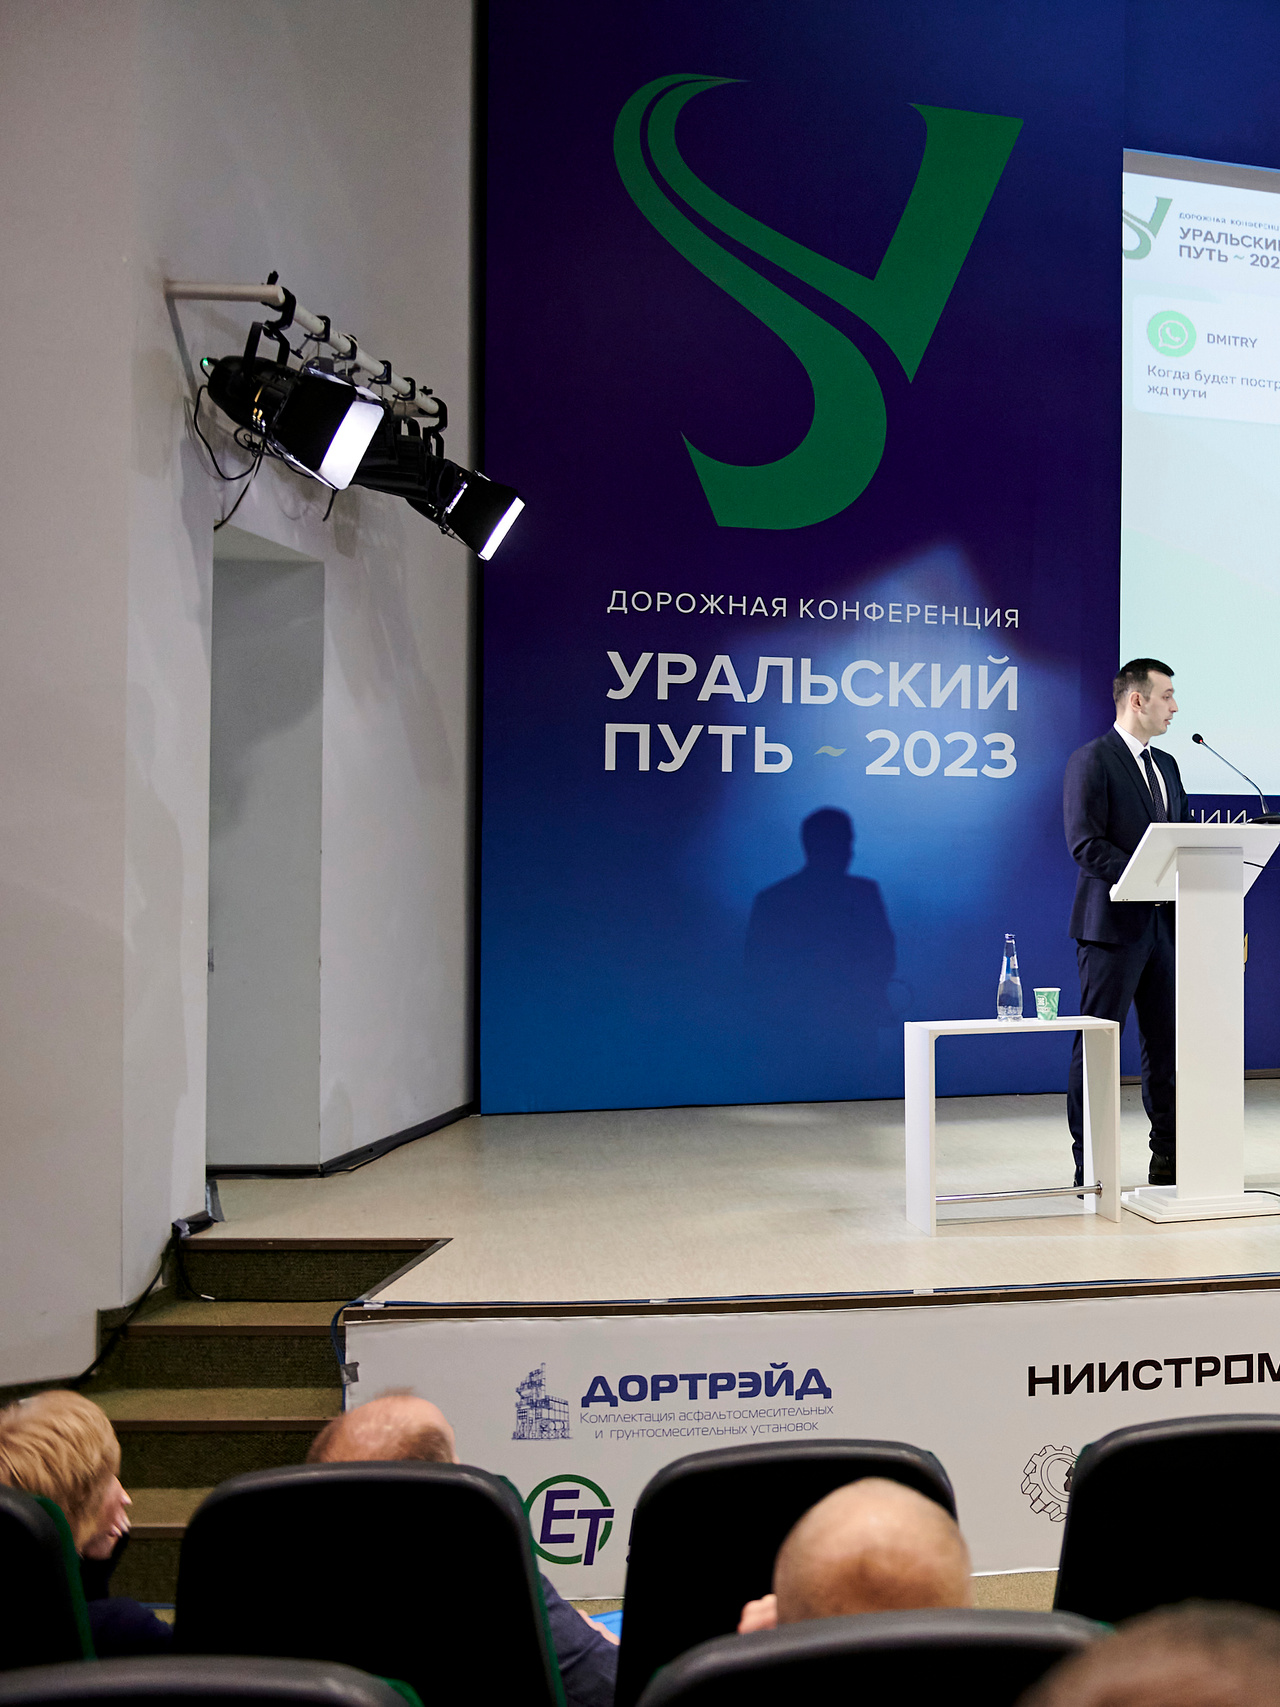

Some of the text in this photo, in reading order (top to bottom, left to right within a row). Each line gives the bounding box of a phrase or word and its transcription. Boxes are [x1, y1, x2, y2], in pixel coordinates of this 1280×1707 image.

[1179, 244, 1228, 263] ПУТЬ
[1206, 333, 1258, 348] DMITRY
[1147, 364, 1190, 381] Когда
[1194, 369, 1237, 385] будет
[1147, 384, 1207, 399] жд пути
[606, 589, 1020, 630] ДОРОЖНАЯ КОНФЕРЕНЦИЯ
[605, 650, 1019, 711] УРАЛЬСКИЙ
[604, 722, 794, 774] ПУТЬ
[865, 728, 1018, 779] 2023
[580, 1361, 833, 1408] ДОРТРЭЙД
[579, 1404, 834, 1424] Комплектация асфальтосмесительных
[594, 1421, 819, 1441] и грунтосмесительных установок
